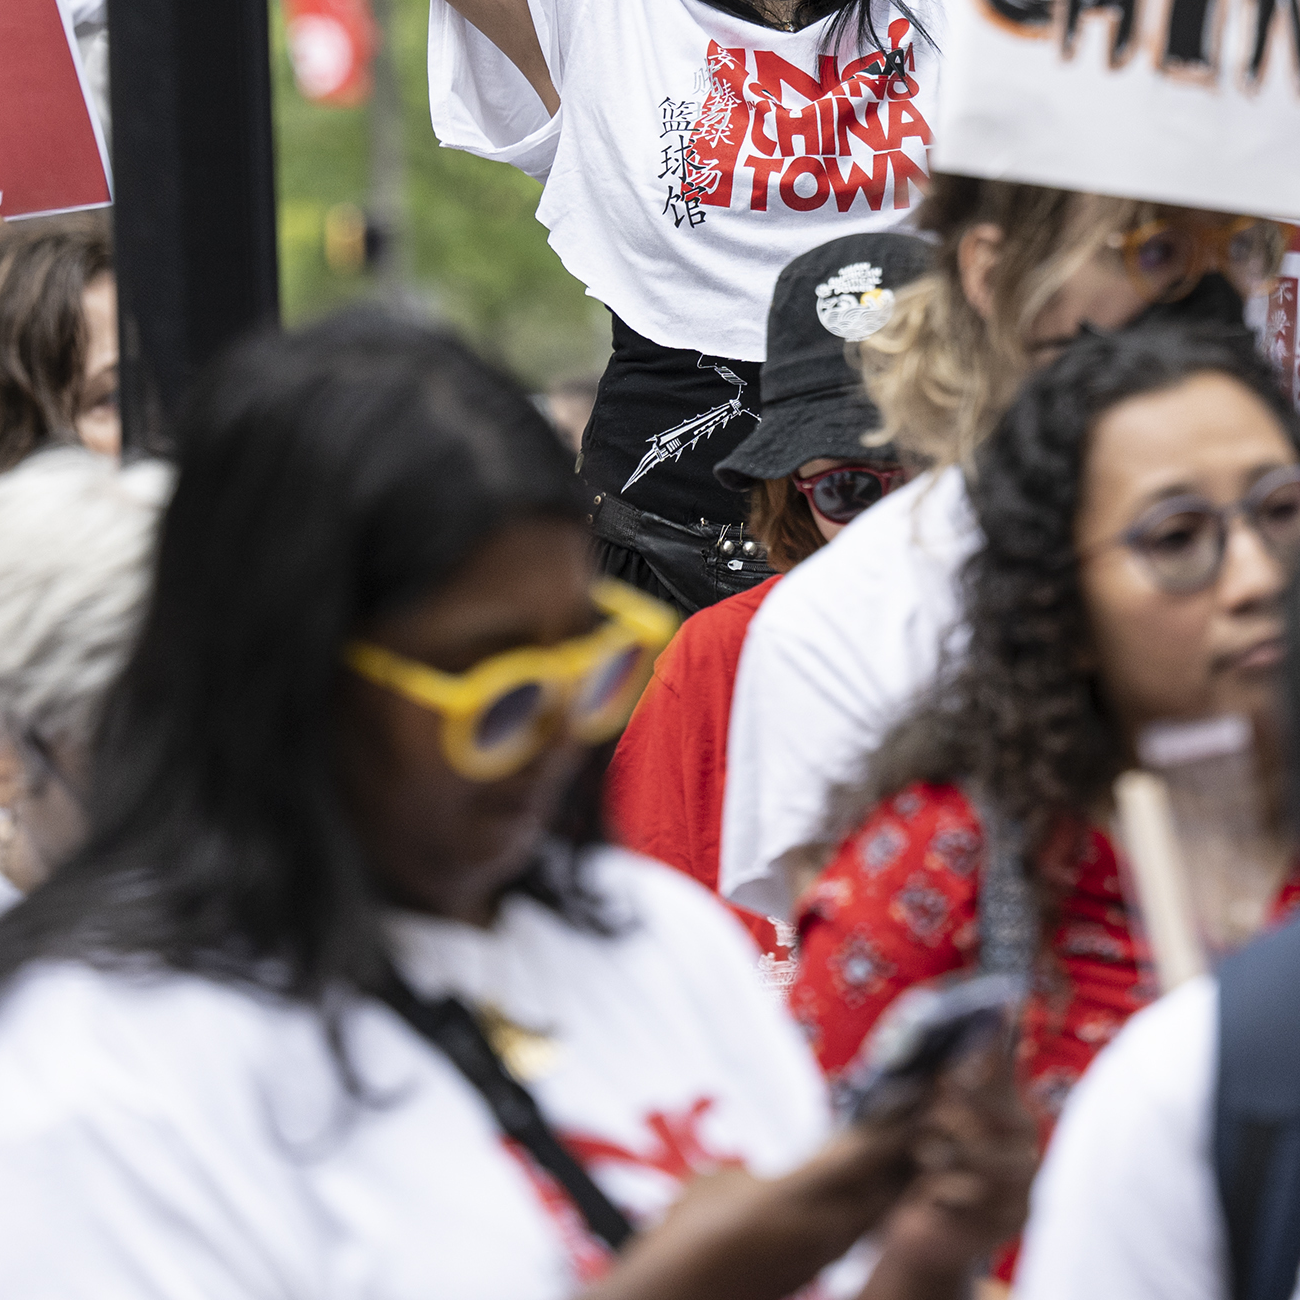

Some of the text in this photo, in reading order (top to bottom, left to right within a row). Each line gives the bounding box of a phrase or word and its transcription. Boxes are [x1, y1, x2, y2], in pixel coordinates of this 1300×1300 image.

[658, 96, 707, 229] 篮球馆
[751, 90, 937, 157] CHINA
